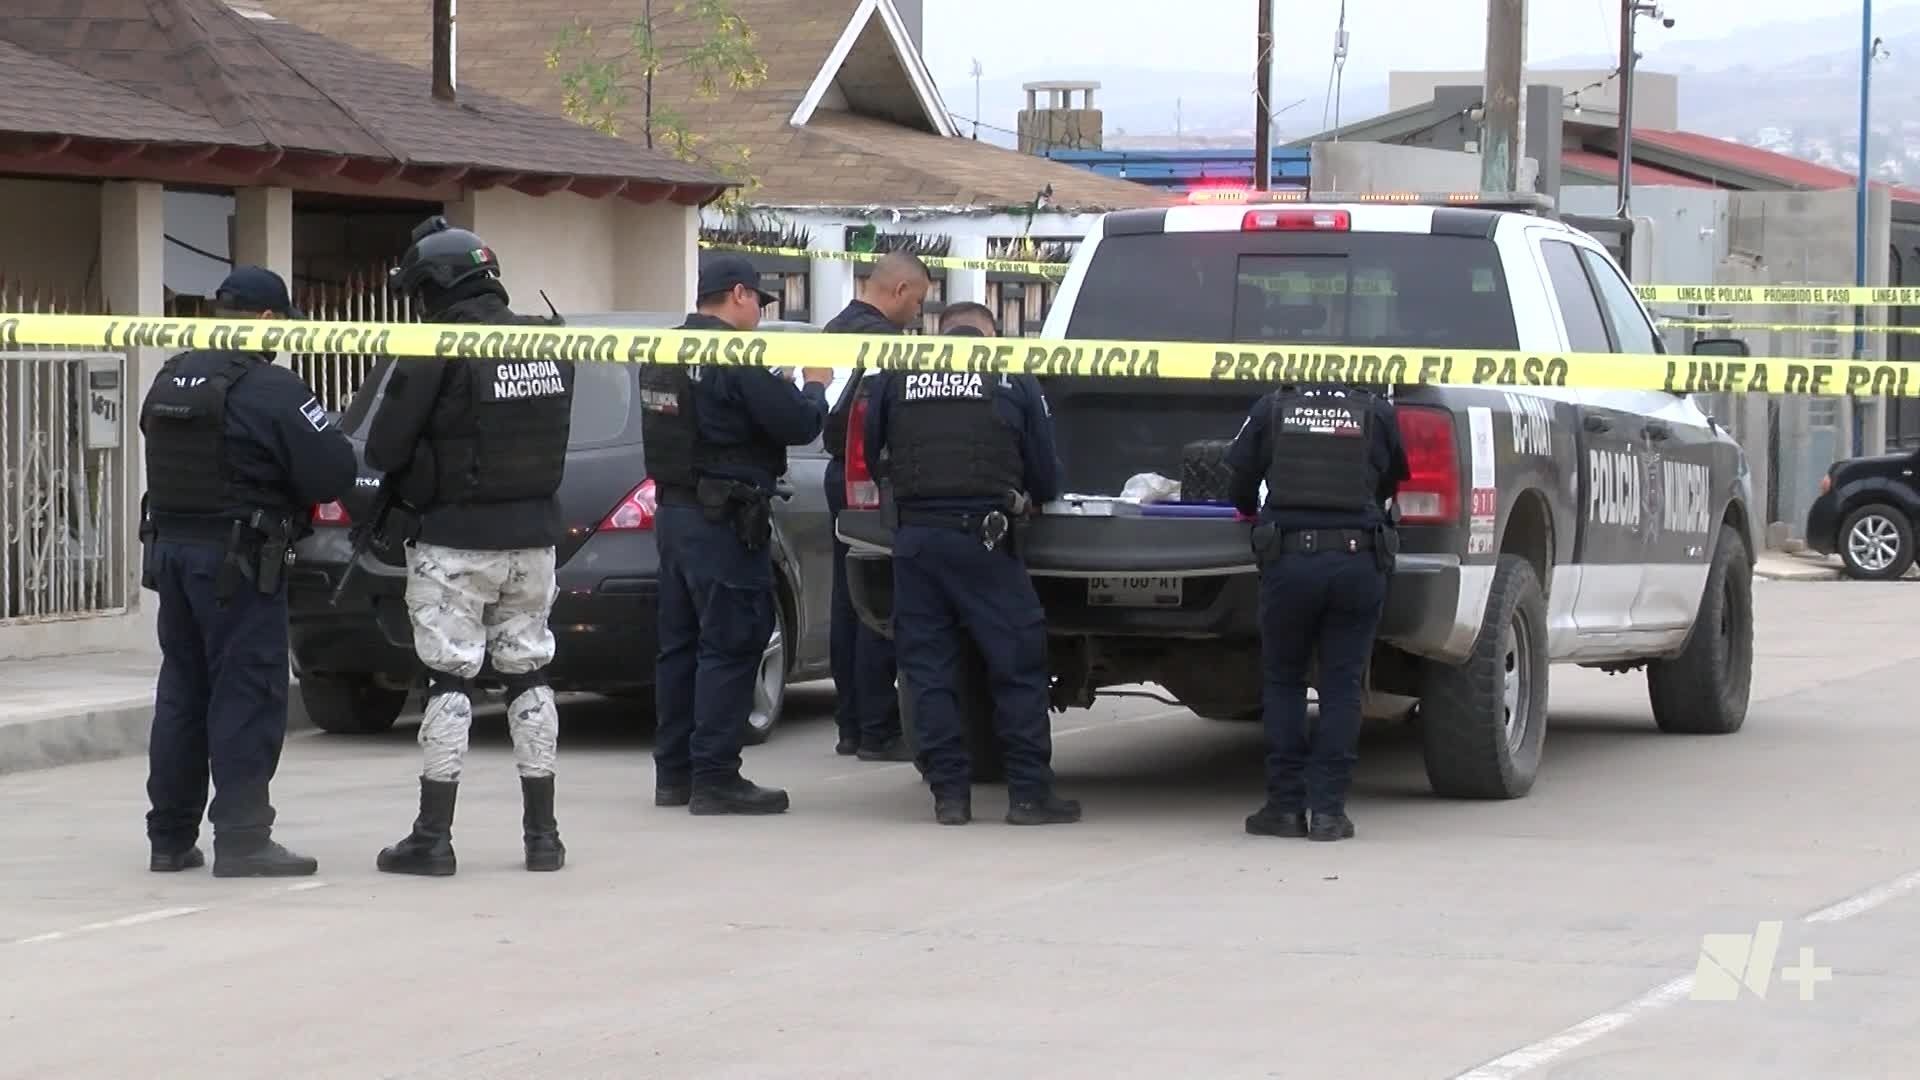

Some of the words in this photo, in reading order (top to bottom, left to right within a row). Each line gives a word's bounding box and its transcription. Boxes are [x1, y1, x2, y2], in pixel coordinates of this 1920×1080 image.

[1677, 287, 1702, 301] LINEA
[1704, 287, 1716, 301] DE
[1718, 289, 1753, 302] POLICIA
[1763, 288, 1812, 302] PROHIBIDO
[1814, 288, 1825, 302] EL
[1827, 288, 1850, 303] PASO
[1872, 288, 1898, 303] LINEA
[1900, 288, 1911, 303] DE
[497, 360, 560, 380] GUARDIA
[494, 377, 565, 398] NACIONAL
[905, 385, 983, 400] MUNICIPAL
[1284, 417, 1361, 428] MUNICIPAL
[1472, 493, 1495, 514] 911
[1663, 460, 1710, 534] MUNICIPAL
